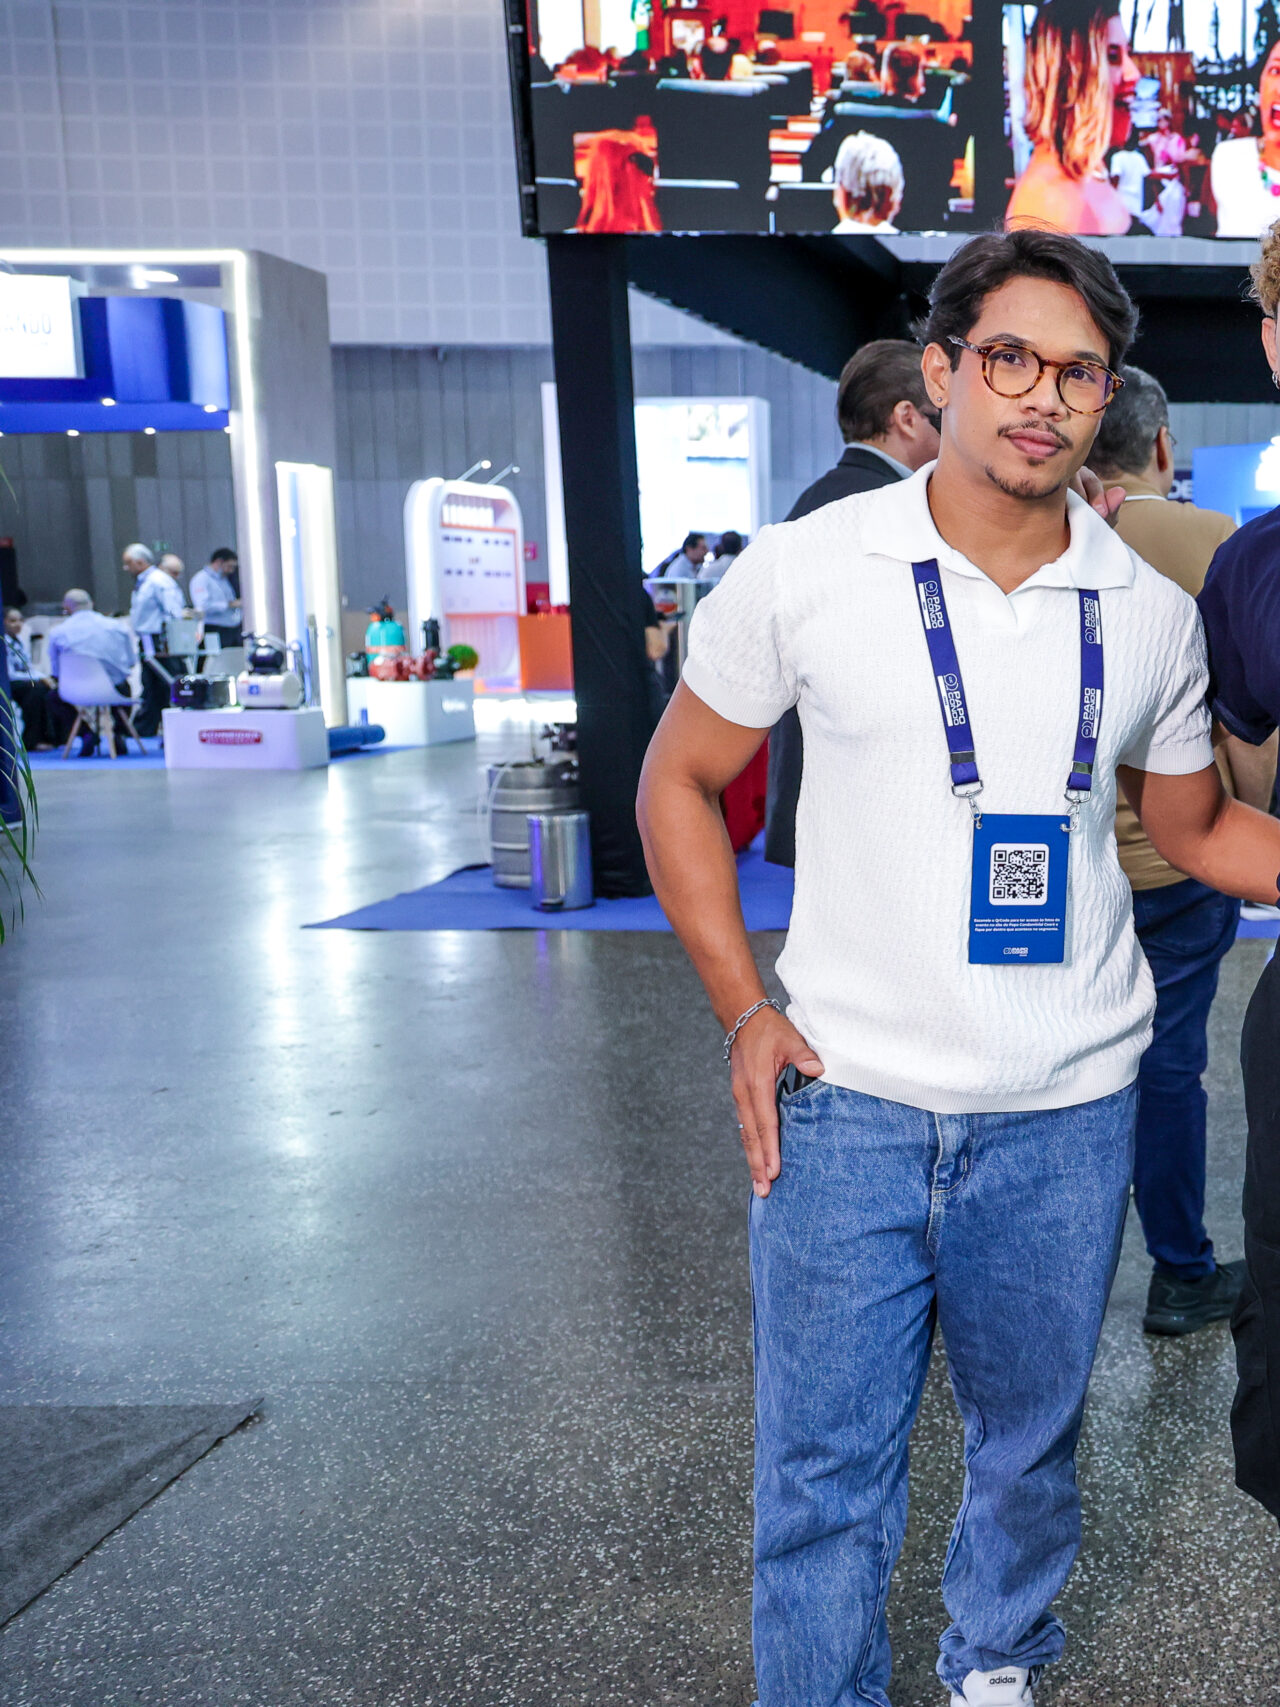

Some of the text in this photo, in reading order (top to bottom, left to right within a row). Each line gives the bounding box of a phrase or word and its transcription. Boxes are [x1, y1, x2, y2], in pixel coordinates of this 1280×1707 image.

[927, 597, 938, 629] CONDO
[932, 596, 944, 628] PAPO
[948, 691, 960, 726] CONDO
[954, 690, 966, 725] PAPO
[1083, 687, 1091, 720] PAPO
[1088, 688, 1096, 721] CONDO
[989, 1675, 1017, 1685] adidas
